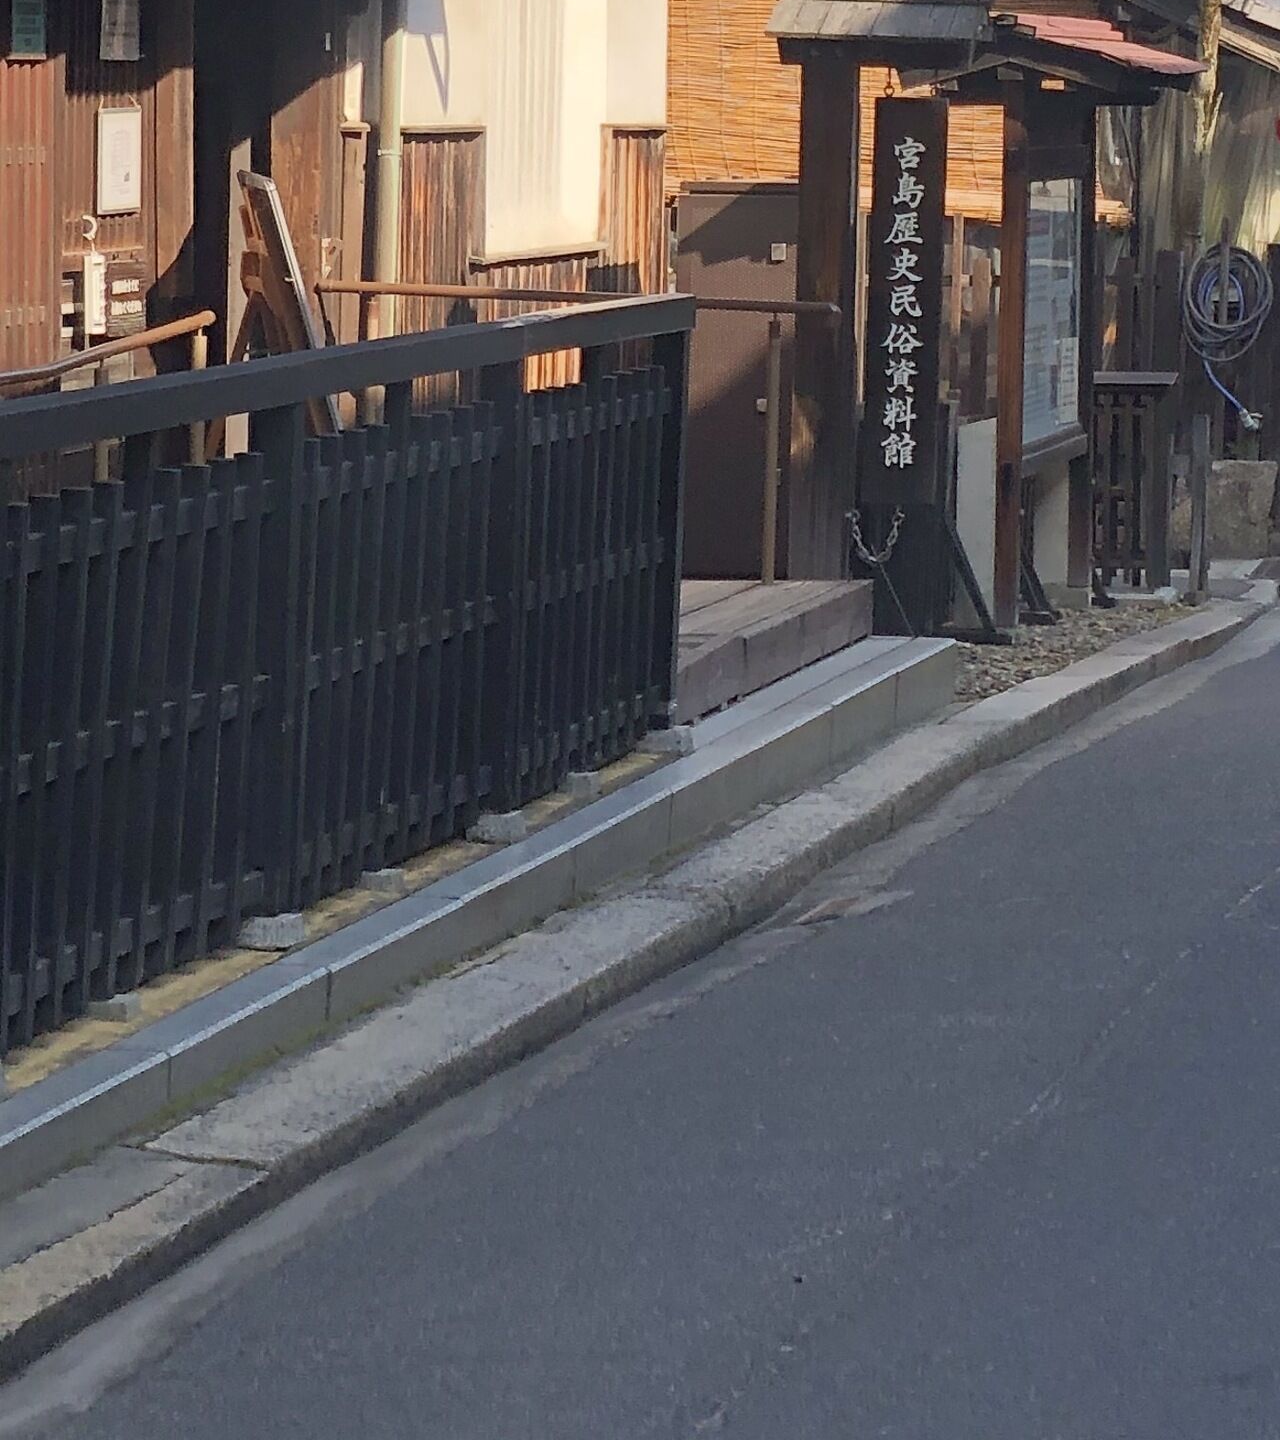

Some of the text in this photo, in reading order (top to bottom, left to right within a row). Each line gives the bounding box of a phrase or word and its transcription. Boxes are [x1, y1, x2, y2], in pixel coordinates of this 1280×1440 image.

[880, 136, 927, 469] 宮島歴史民俗資料館
